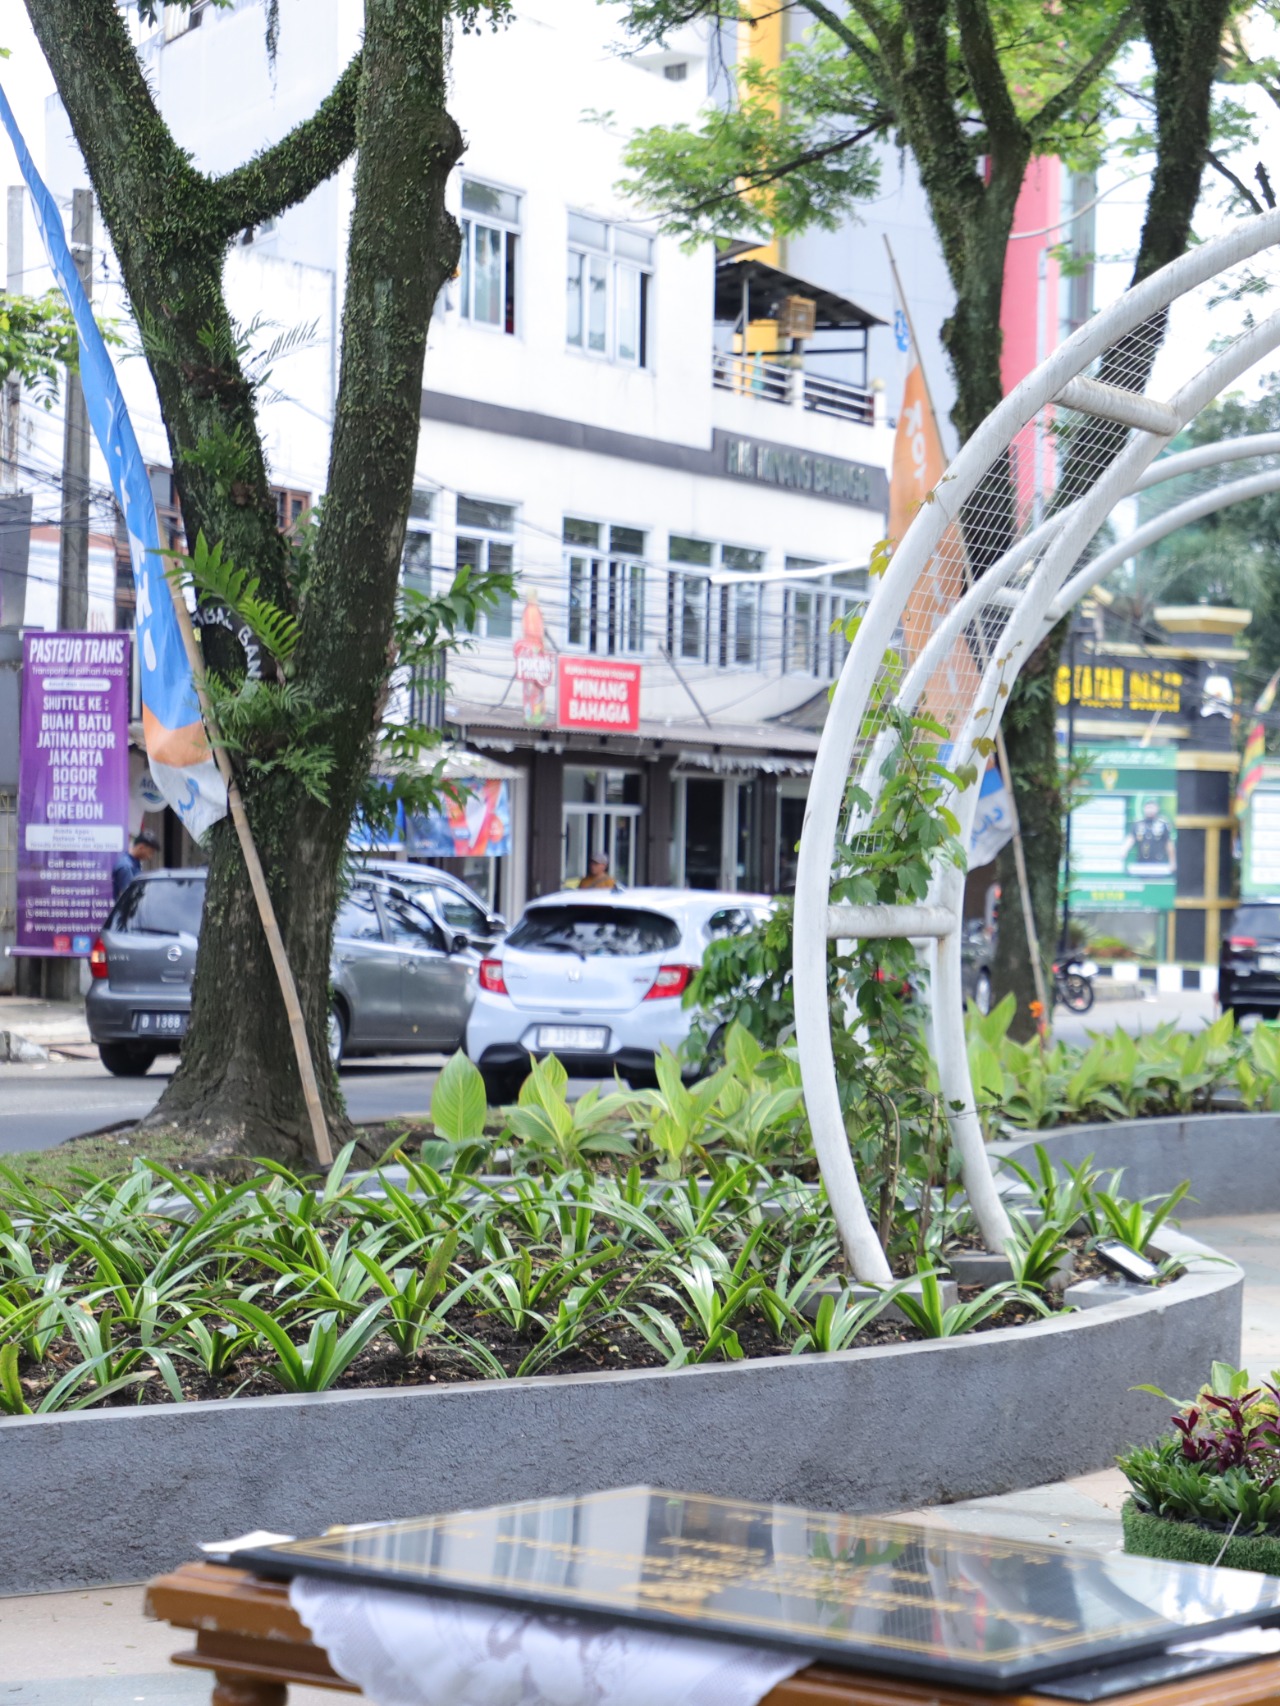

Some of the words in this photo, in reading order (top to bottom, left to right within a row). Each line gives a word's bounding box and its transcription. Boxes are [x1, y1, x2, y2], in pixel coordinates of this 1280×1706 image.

[30, 638, 82, 664] PASTEUR
[84, 638, 125, 665] TRANS
[572, 677, 629, 702] MINANG
[43, 695, 86, 711] SHUTTLE
[88, 696, 102, 711] KE
[568, 699, 631, 724] BAHAGIA
[41, 713, 74, 731] BUAH
[78, 713, 112, 731] BATU
[36, 731, 116, 749] JATINANGOR
[47, 749, 104, 767] JAKARTA
[52, 767, 98, 784] BOGOR
[53, 784, 98, 802] DEPOK
[46, 802, 104, 820] CIREBON
[47, 860, 65, 869] Call
